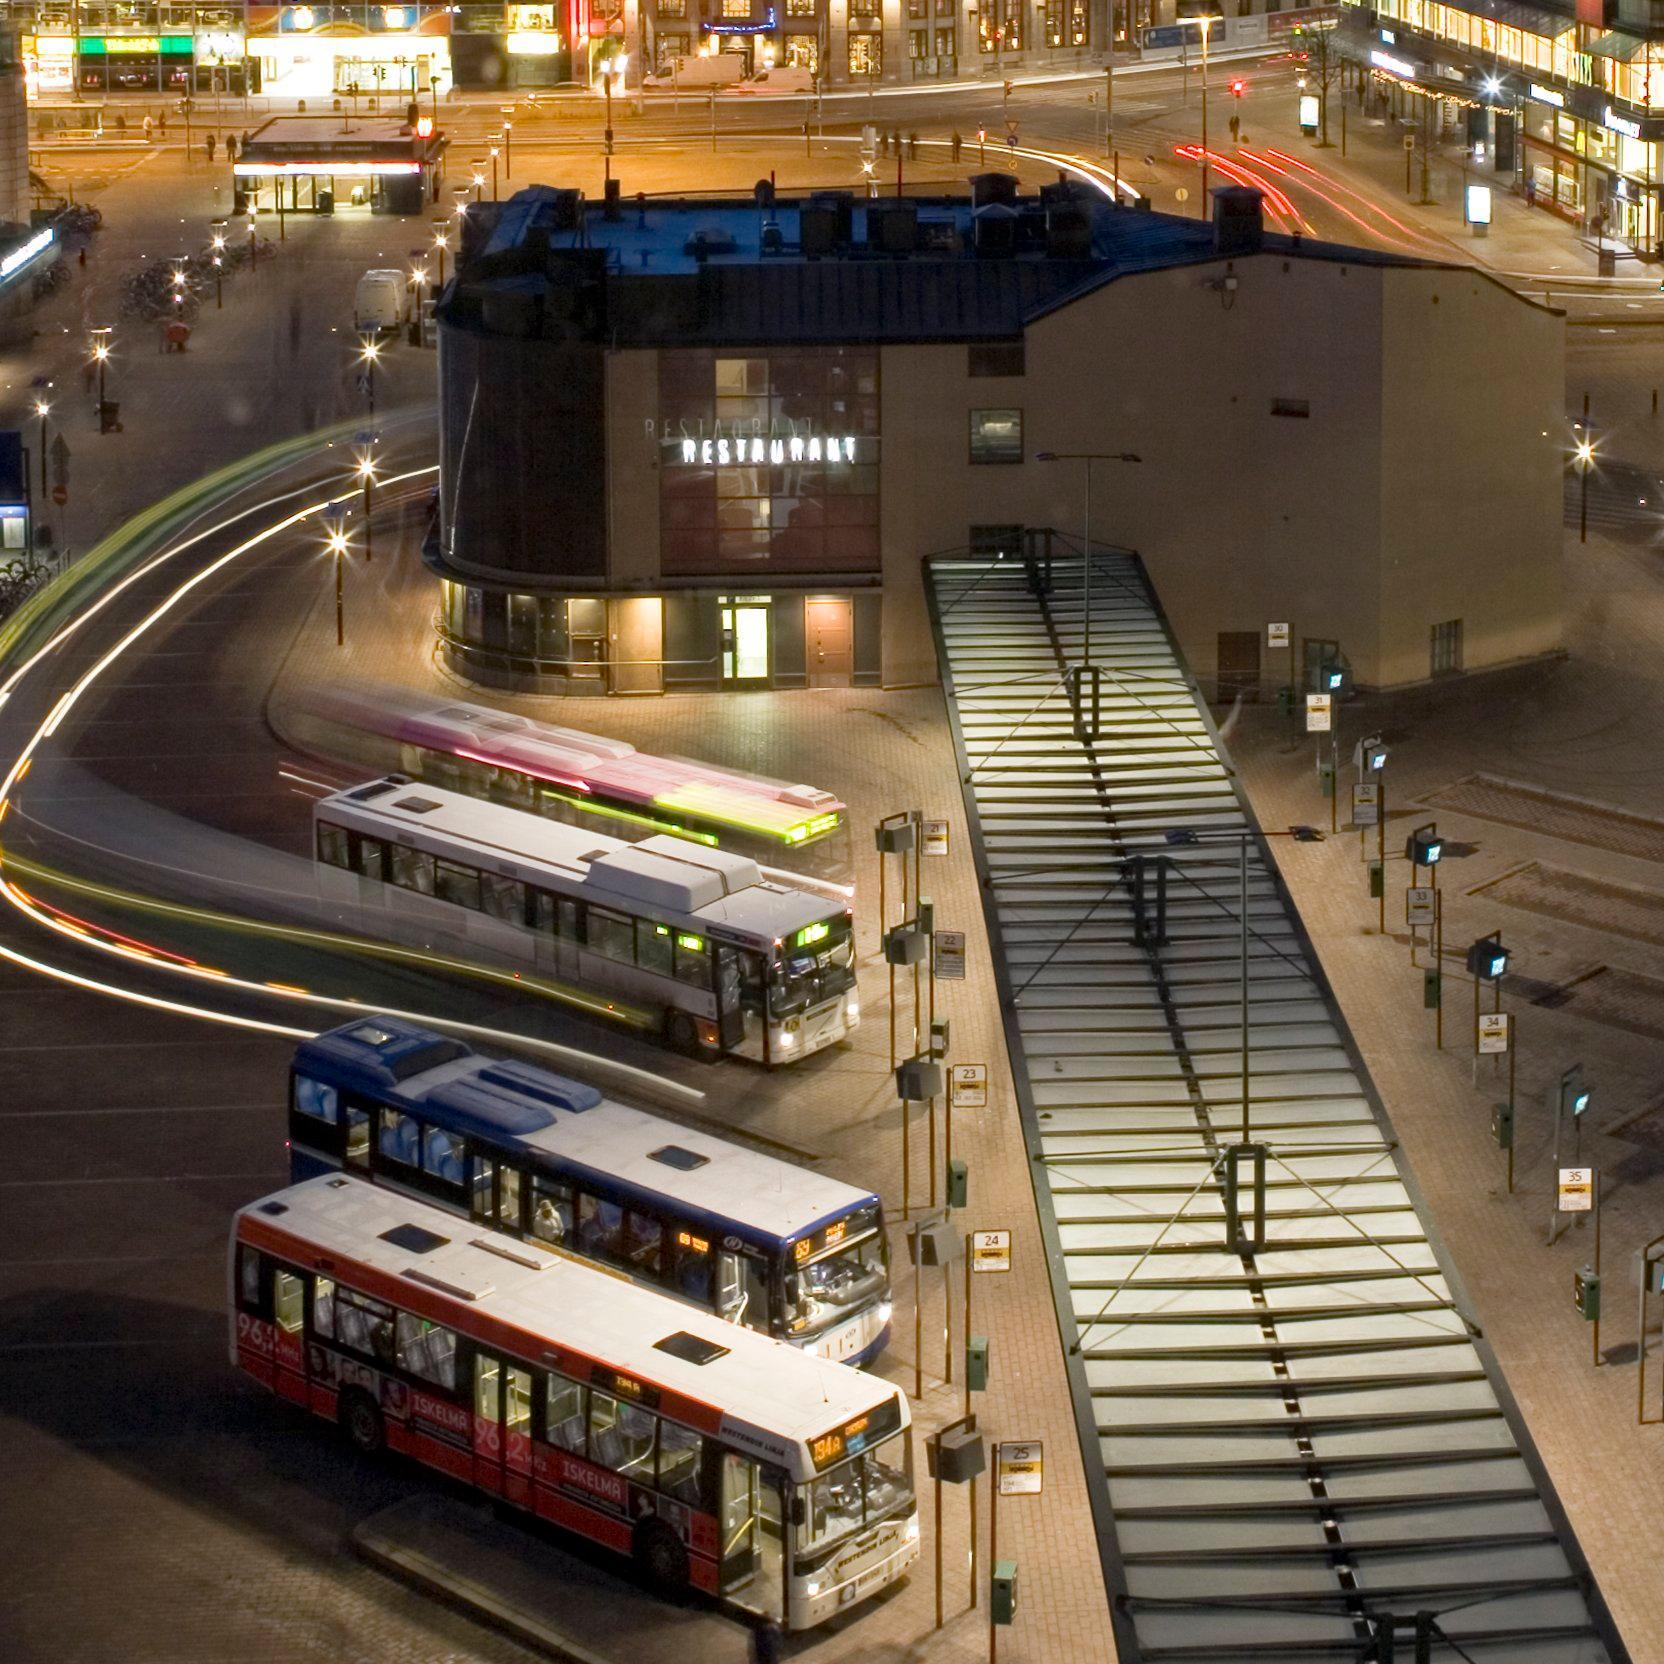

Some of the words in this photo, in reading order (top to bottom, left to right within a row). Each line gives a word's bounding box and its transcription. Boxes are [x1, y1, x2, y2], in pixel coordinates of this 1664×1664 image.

[682, 437, 857, 464] RESTAURANT
[930, 824, 940, 833] 21
[1415, 891, 1427, 901] 33
[945, 936, 956, 945] 22
[1486, 1017, 1499, 1027] 34
[963, 1068, 977, 1079] 23
[1568, 1171, 1582, 1182] 35
[985, 1235, 999, 1246] 24
[413, 1394, 468, 1428] ISKELMÄ
[1013, 1446, 1030, 1460] 25
[562, 1459, 623, 1499] ISKELMÄ
